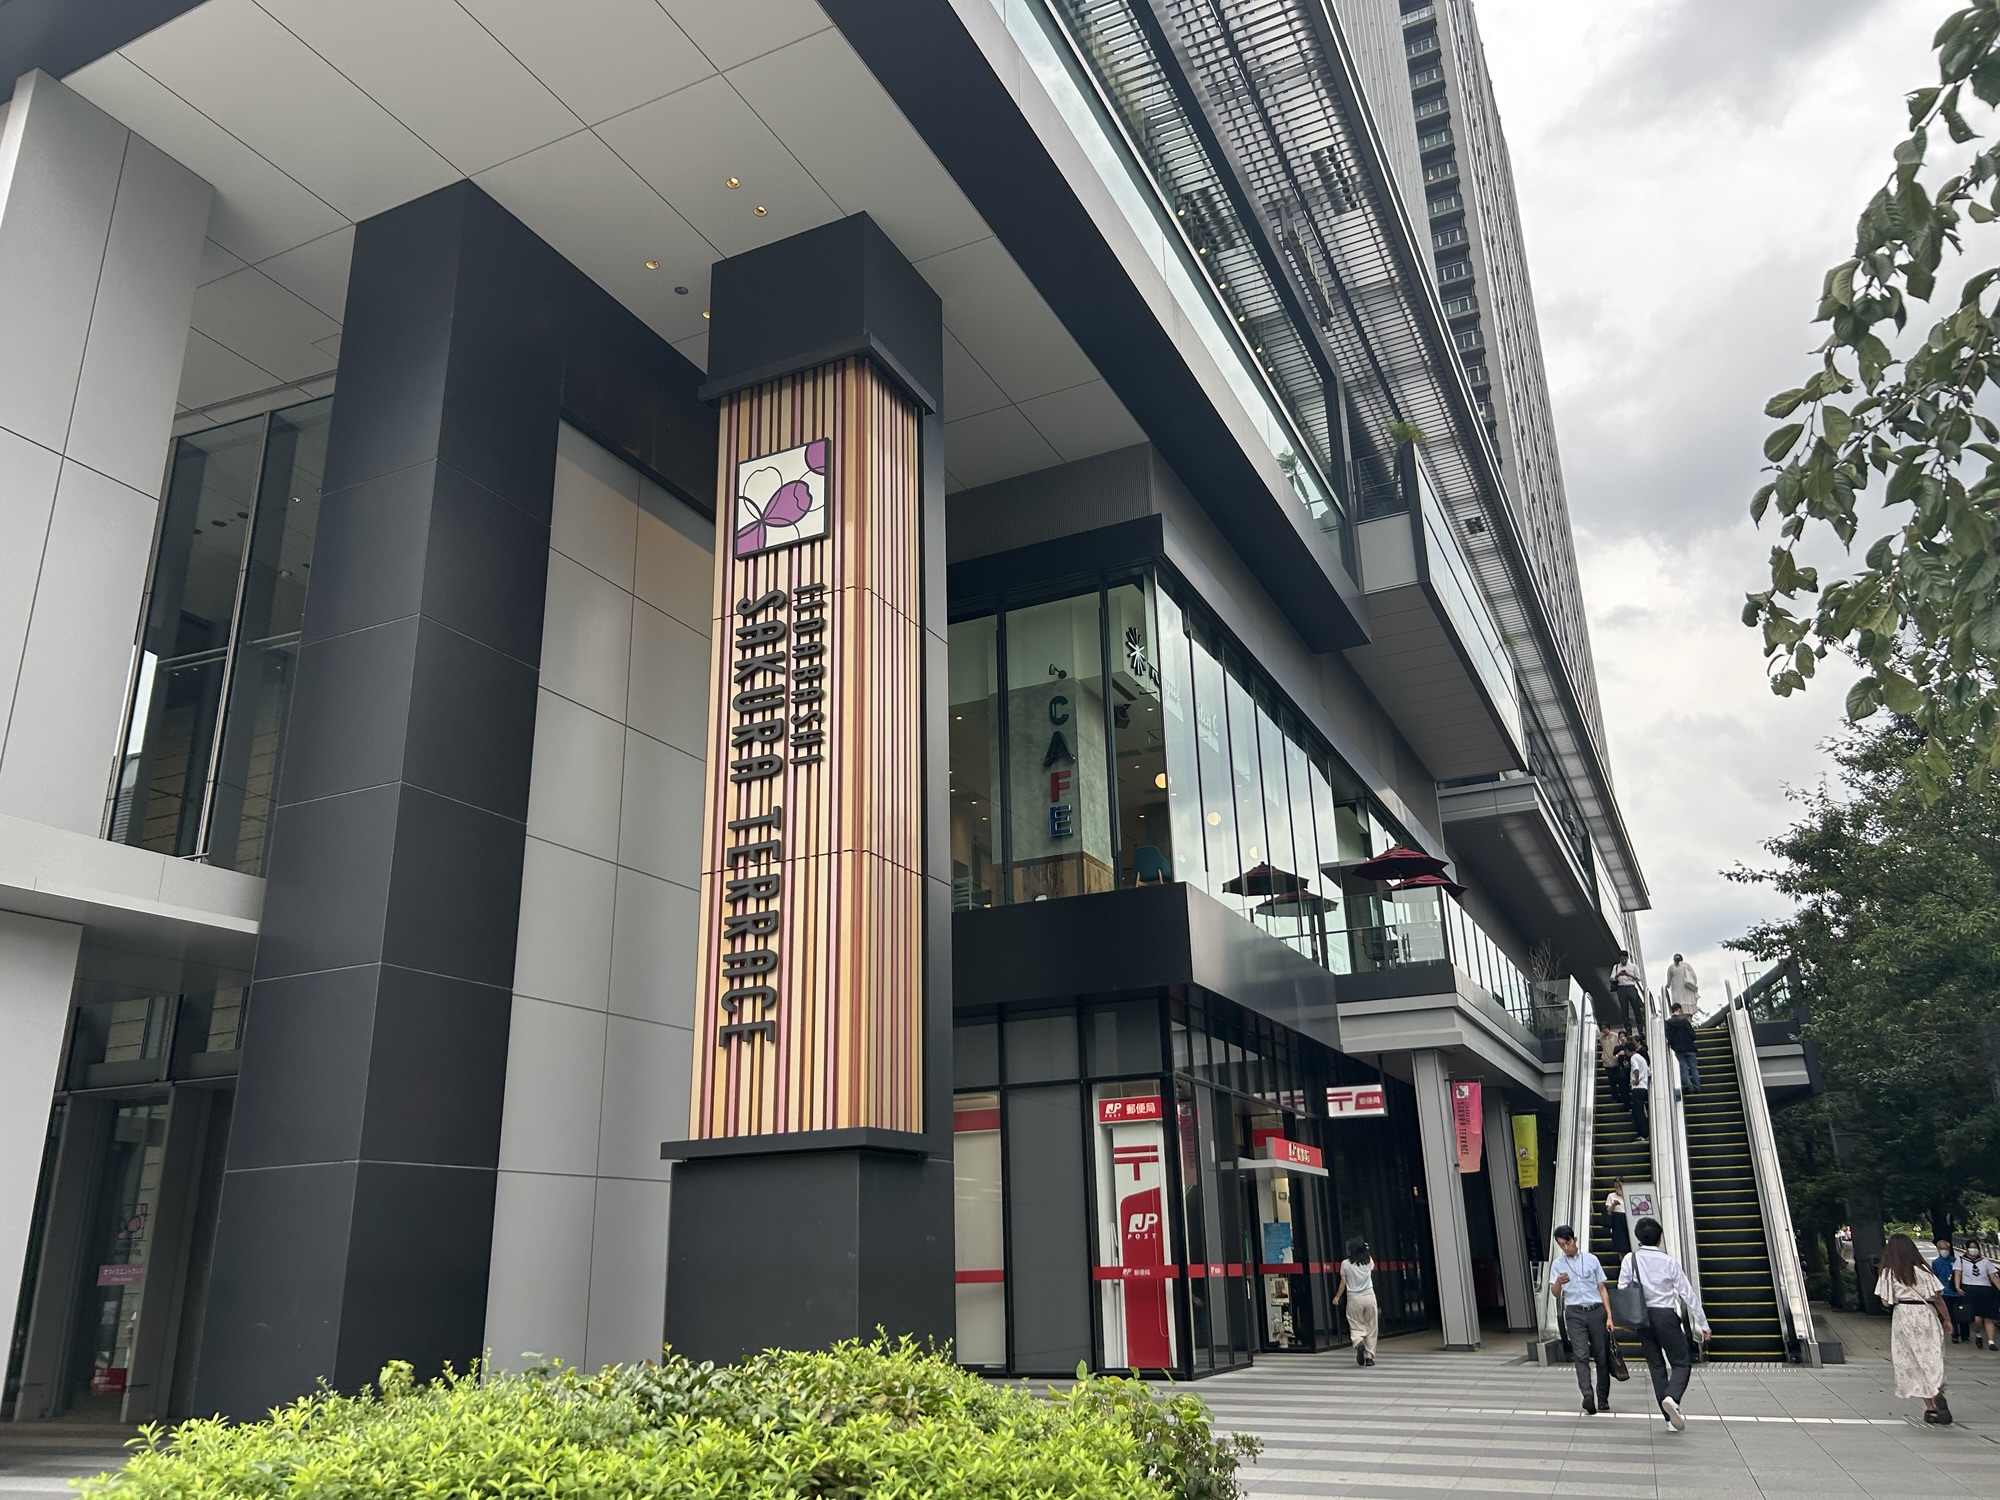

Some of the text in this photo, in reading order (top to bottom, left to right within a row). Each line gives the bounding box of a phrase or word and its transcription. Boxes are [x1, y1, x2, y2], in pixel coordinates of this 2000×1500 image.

[790, 582, 826, 766] IIDABASHI
[1043, 695, 1076, 838] CAFE
[719, 588, 787, 1050] SAKURA TERRACE
[1126, 1102, 1156, 1115] 郵便局
[1457, 1102, 1469, 1156] SAKURA TERRACE
[1128, 1213, 1158, 1232] JP
